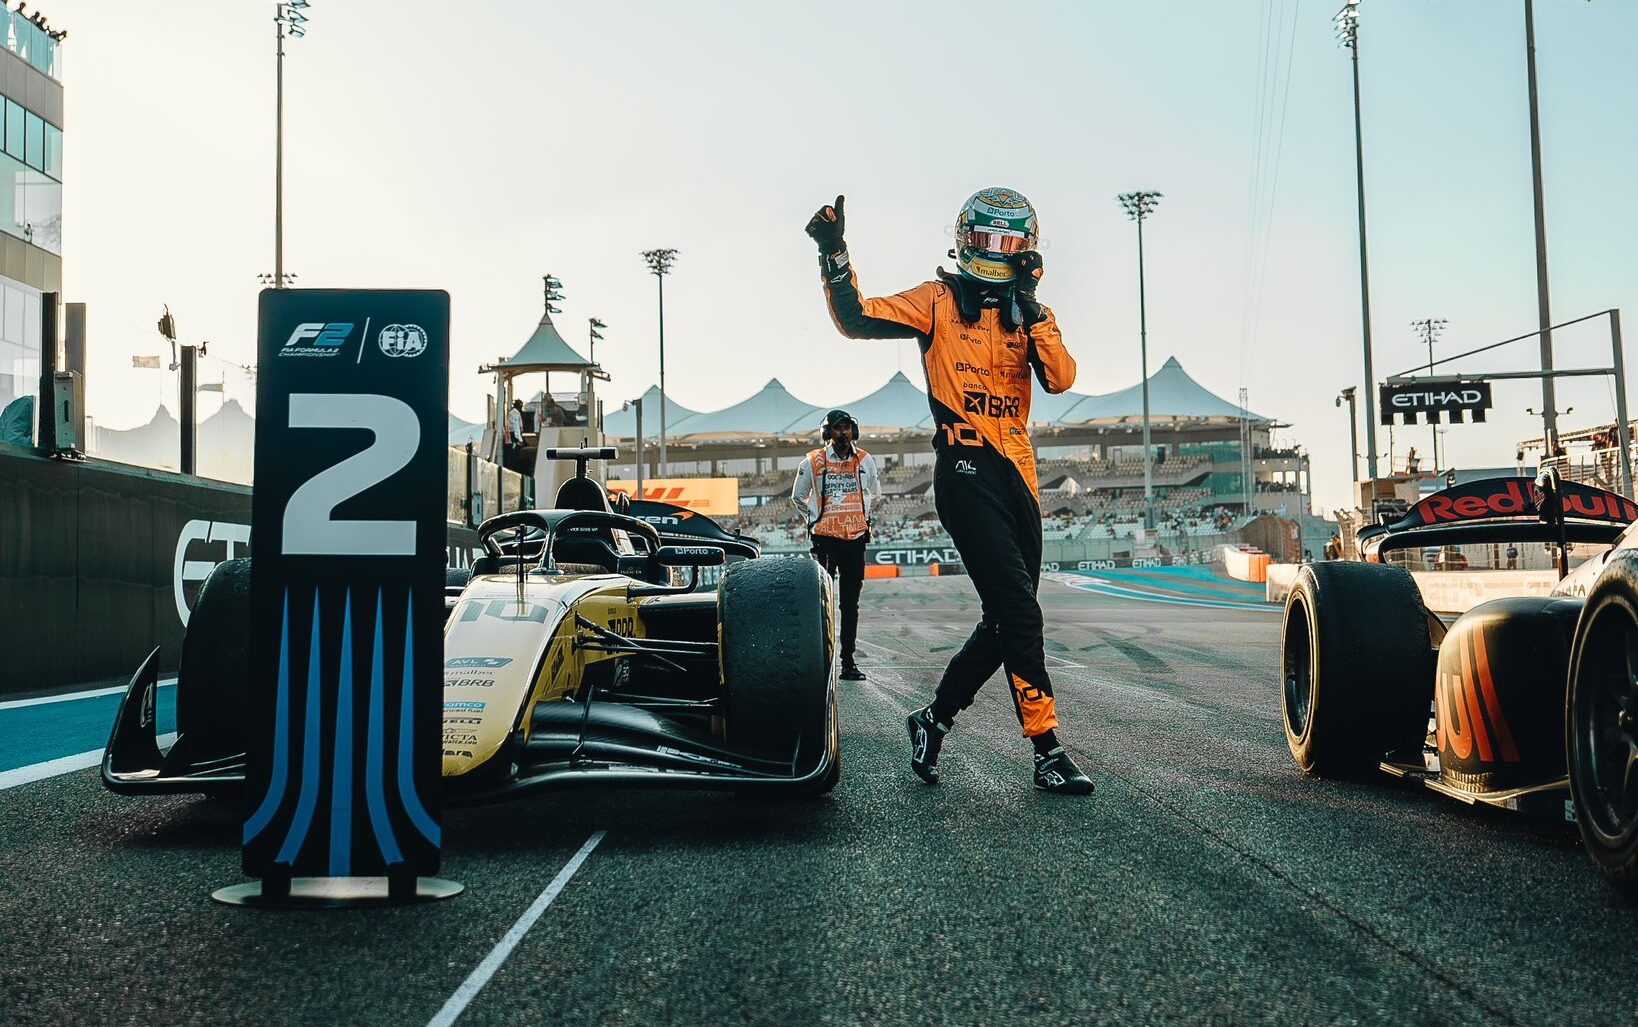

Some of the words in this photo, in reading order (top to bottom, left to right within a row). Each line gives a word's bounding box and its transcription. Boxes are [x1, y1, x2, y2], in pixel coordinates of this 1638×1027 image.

[285, 322, 355, 346] F2
[965, 362, 990, 377] Porto
[963, 382, 987, 391] banco
[1391, 389, 1482, 408] ETIHAD
[941, 422, 984, 447] 10
[281, 392, 421, 556] 2
[1417, 481, 1525, 525] Red
[1527, 481, 1638, 522] ull
[1077, 560, 1116, 571] ETIHAD
[1132, 557, 1162, 568] ETIHAD
[458, 679, 496, 688] BRB
